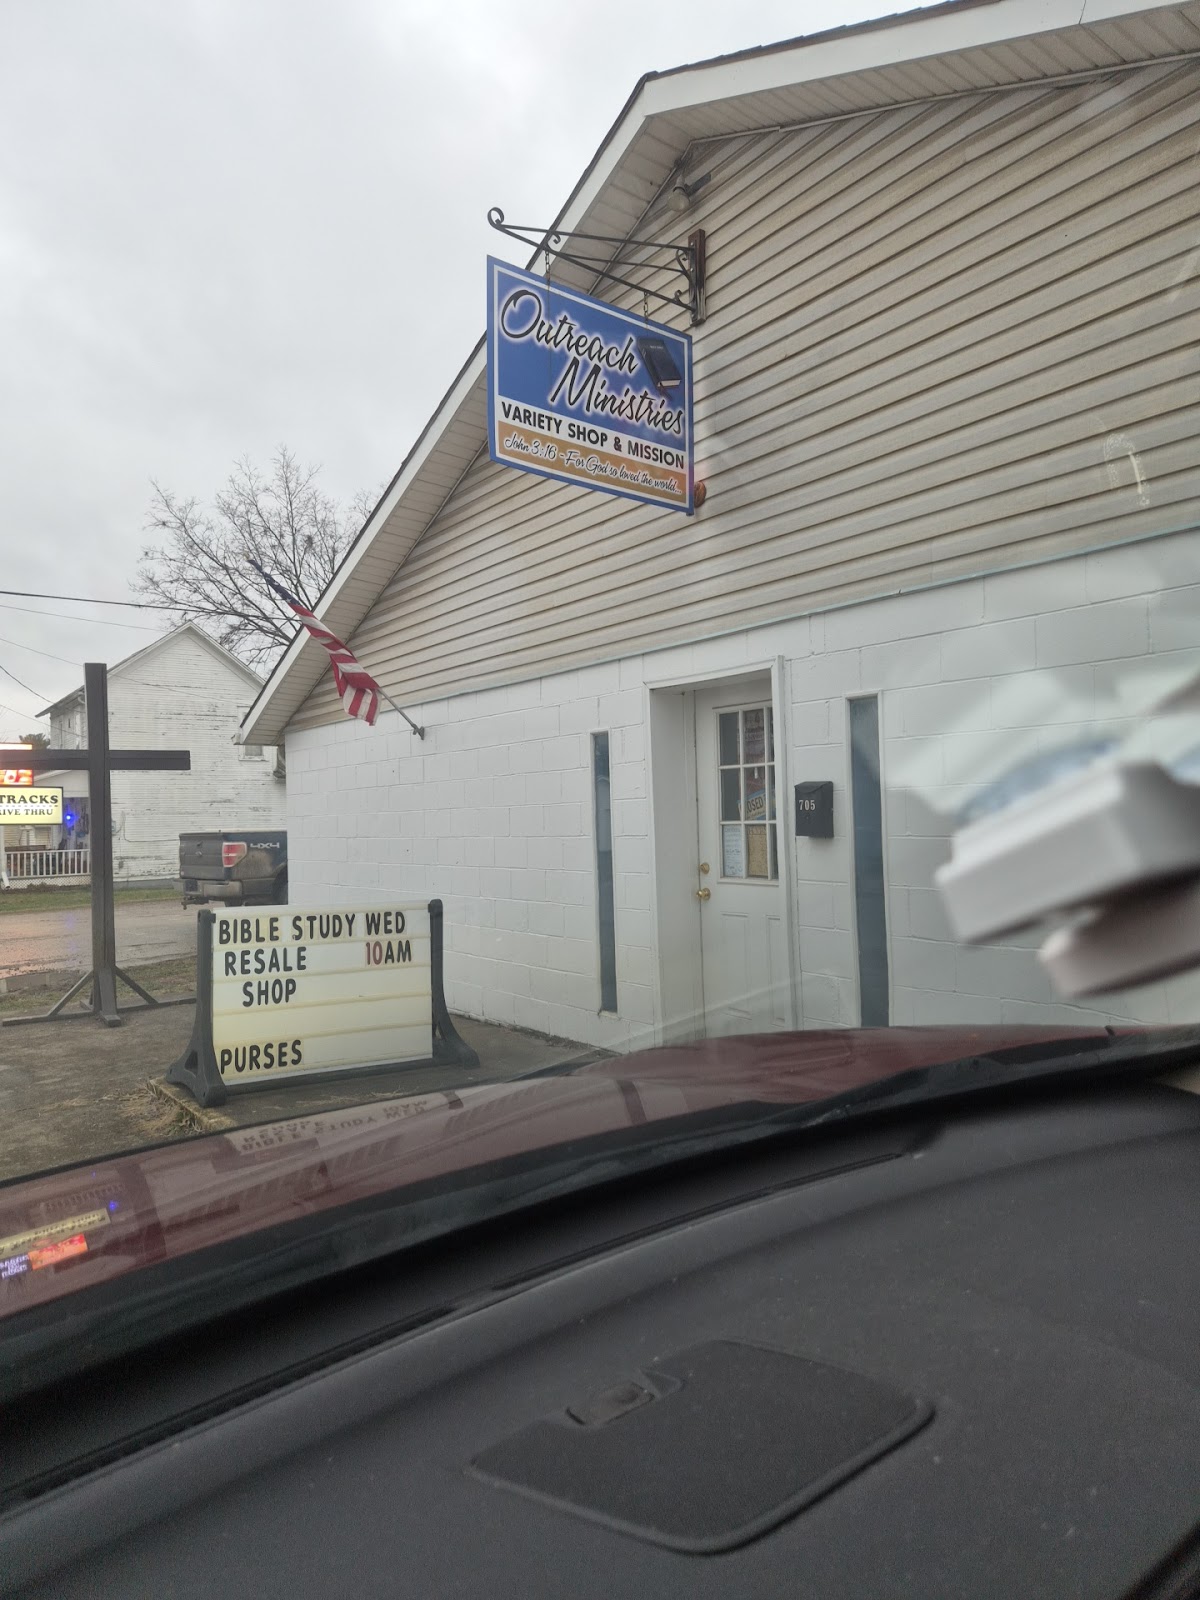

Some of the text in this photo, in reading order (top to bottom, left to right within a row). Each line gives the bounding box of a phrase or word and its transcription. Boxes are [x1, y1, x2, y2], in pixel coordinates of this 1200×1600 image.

[501, 289, 638, 374] Outreach
[551, 356, 684, 435] Ministries
[501, 401, 685, 470] VARIETY SHOP & MISSION
[504, 433, 530, 453] John
[531, 440, 557, 460] 3:16
[586, 456, 608, 474] God
[609, 467, 618, 477] so
[619, 465, 640, 482] loved
[641, 472, 653, 486] the
[0, 794, 58, 804] TRACKS
[24, 808, 53, 816] THRU
[798, 799, 816, 811] 705
[218, 911, 406, 945] BIBLE STUDY WED
[224, 946, 307, 977] RESALE
[365, 939, 412, 966] 10AM
[242, 978, 297, 1008] SHOP
[220, 1039, 302, 1075] PURSES
